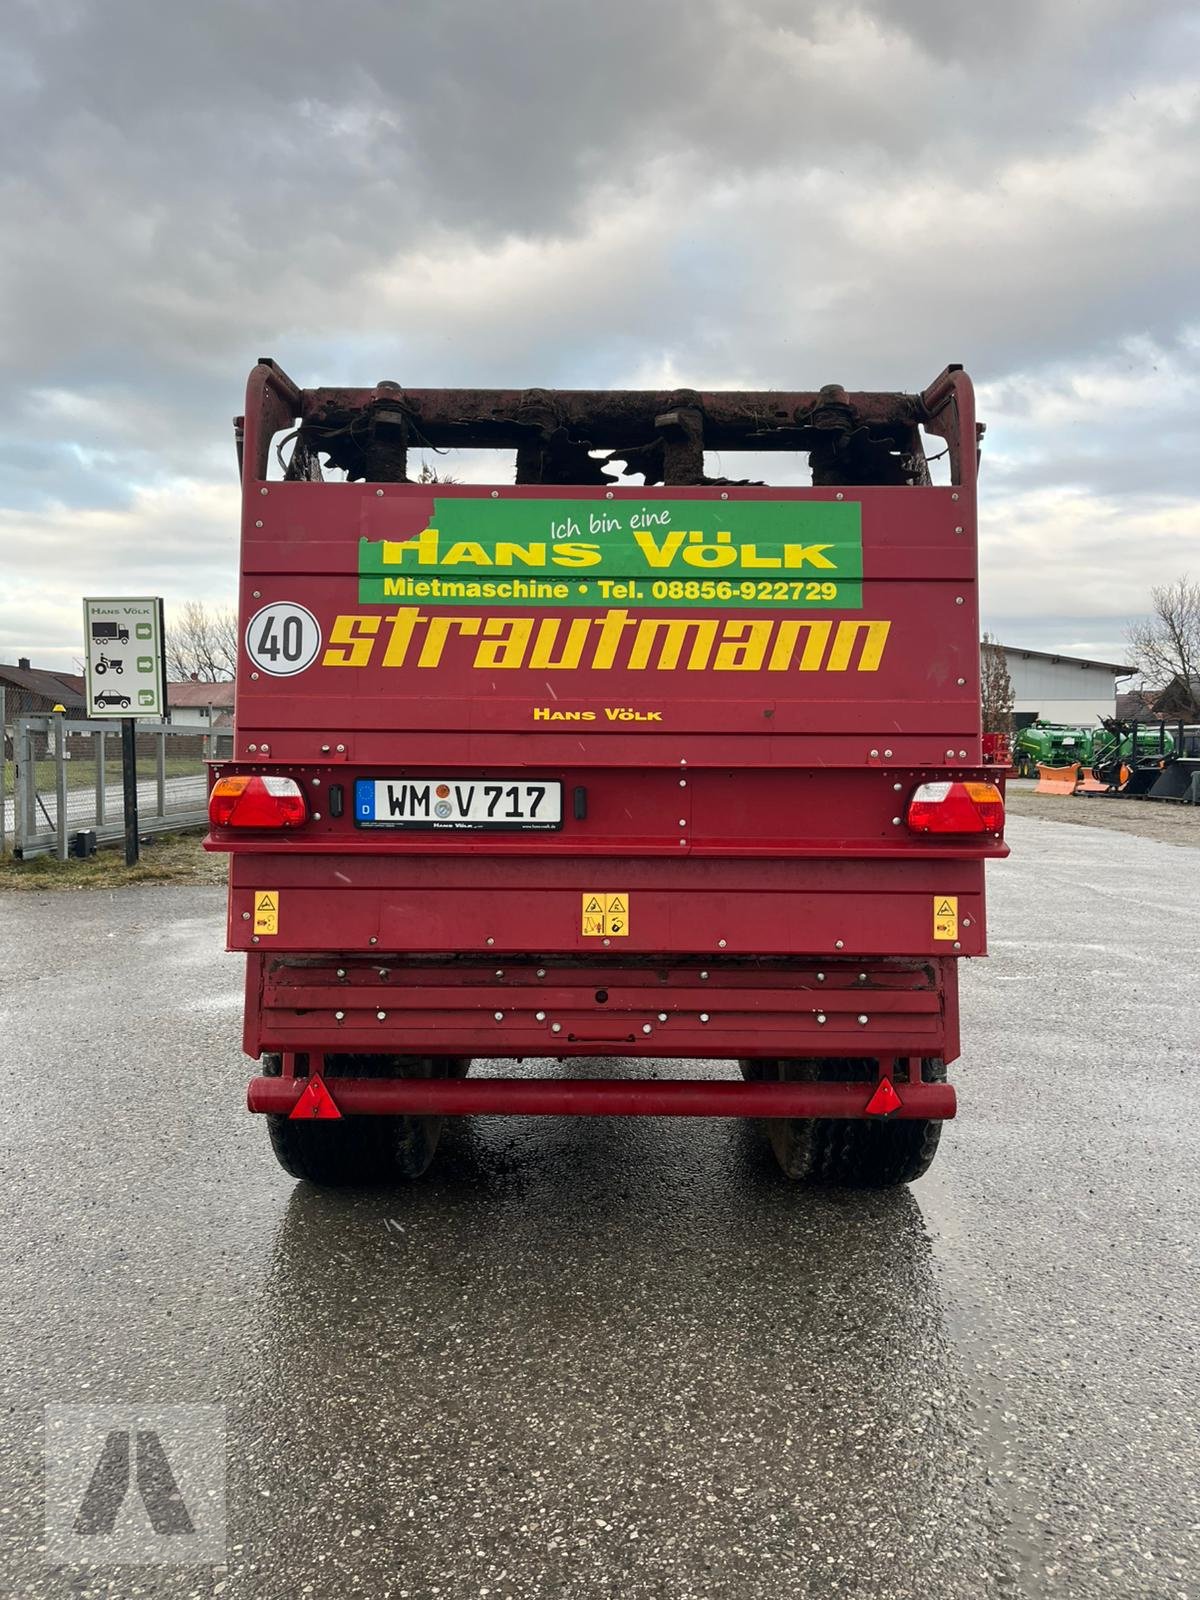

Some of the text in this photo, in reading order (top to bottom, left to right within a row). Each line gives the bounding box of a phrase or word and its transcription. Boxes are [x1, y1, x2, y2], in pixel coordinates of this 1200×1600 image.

[550, 507, 672, 540] Ich bin eine
[382, 529, 838, 569] HANS VÖLK
[383, 577, 838, 600] Mietmaschine Tel. 08856-922729
[91, 607, 120, 615] HANS
[257, 615, 303, 662] 40
[322, 606, 892, 672] strautmann
[533, 707, 663, 721] HANS VÖLK
[361, 805, 370, 815] D
[386, 784, 546, 818] WM V 717
